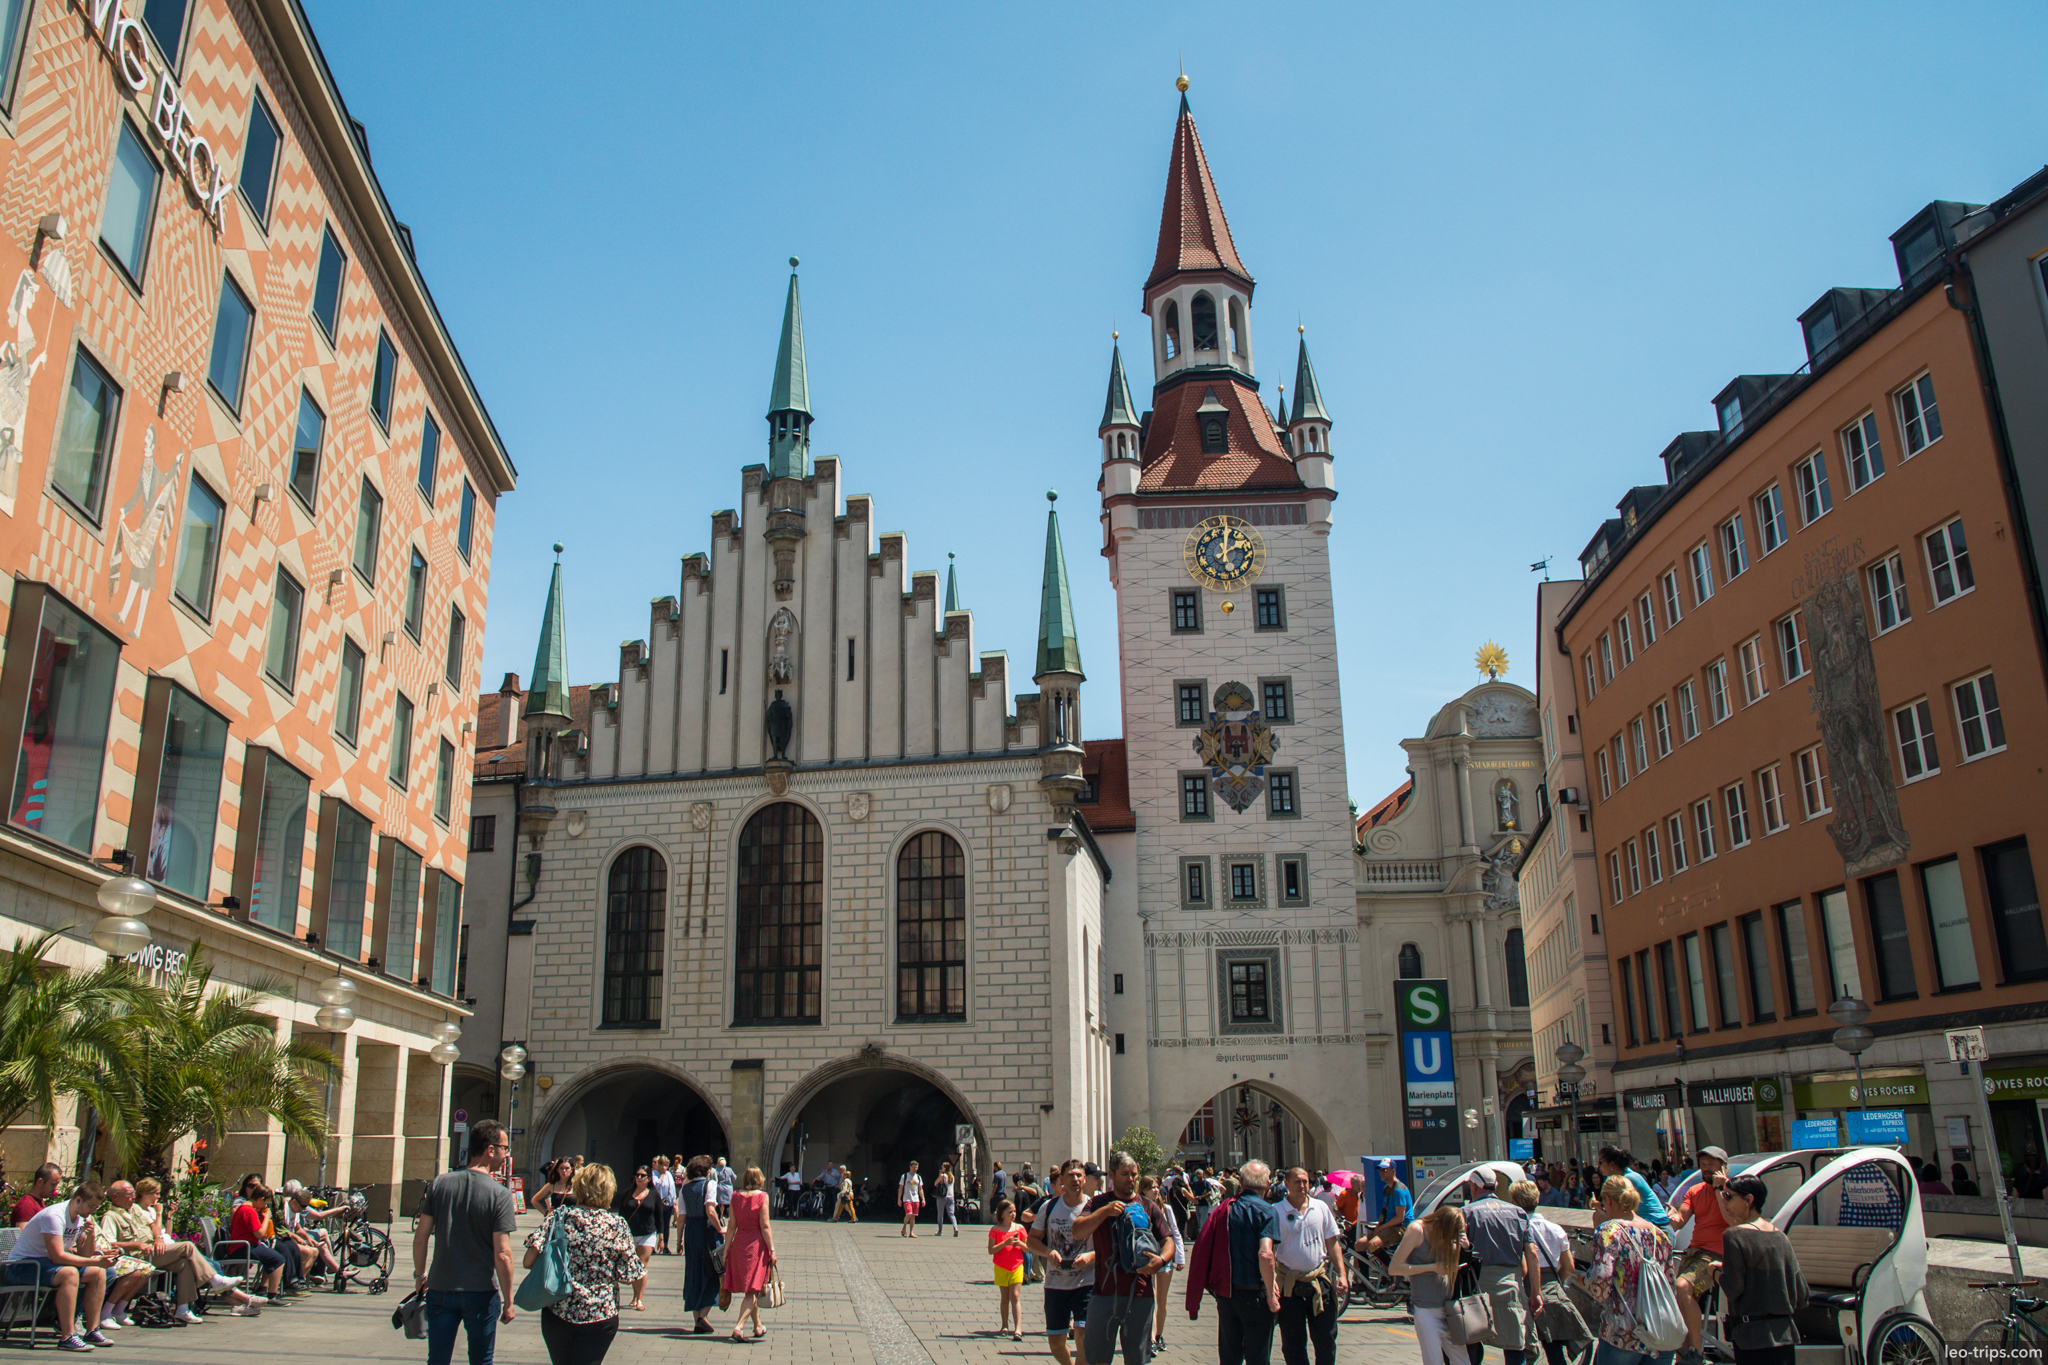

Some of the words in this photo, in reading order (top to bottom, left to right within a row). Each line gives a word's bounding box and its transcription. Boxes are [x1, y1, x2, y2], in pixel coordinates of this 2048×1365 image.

[153, 70, 232, 234] BECK
[1803, 534, 1840, 570] SANCT
[1410, 986, 1440, 1024] S
[1215, 1053, 1289, 1063] Spielzeugmuseum
[1413, 1037, 1441, 1075] U
[1996, 1078, 2023, 1090] YVES
[1408, 1091, 1453, 1100] Marienplatz
[1702, 1086, 1754, 1104] HALLHUBER
[1863, 1087, 1878, 1097] VES
[1880, 1085, 1916, 1096] ROCHER
[1632, 1094, 1666, 1109] HALLHUBER
[1862, 1112, 1903, 1121] LEDERHOSEN
[1805, 1120, 1836, 1128] LEDERHOSEN
[1847, 1185, 1884, 1194] Lederhosen
